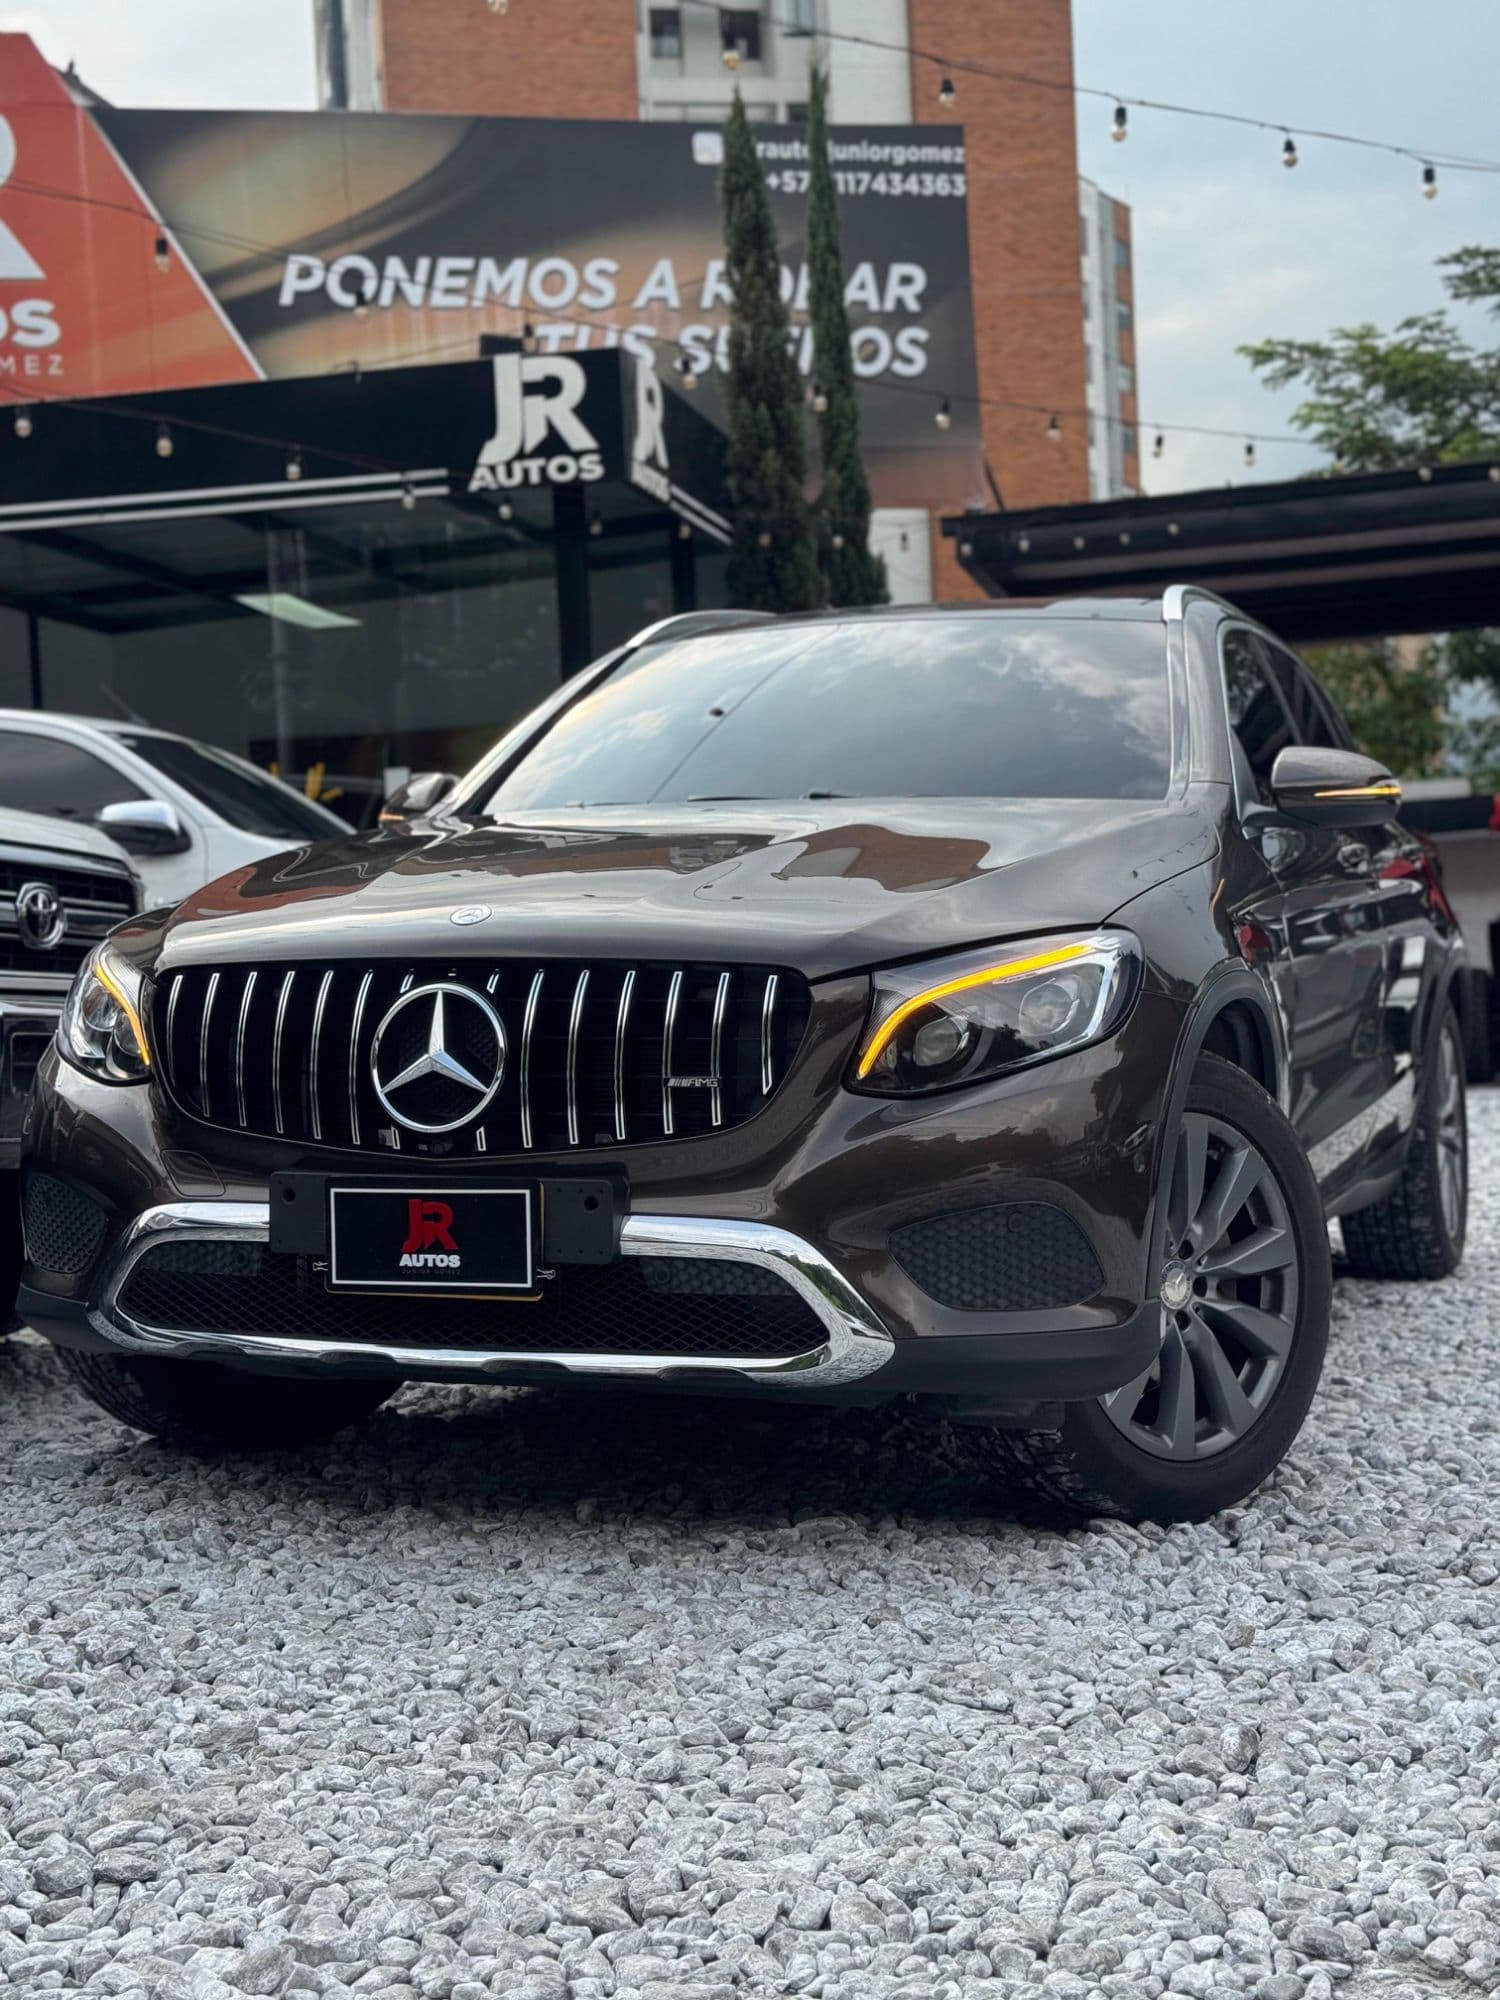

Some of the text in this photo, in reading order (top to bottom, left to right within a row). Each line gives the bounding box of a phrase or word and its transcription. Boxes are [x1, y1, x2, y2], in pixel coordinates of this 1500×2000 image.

[834, 172, 967, 197] 117434363
[279, 254, 620, 310] PONEMOS
[633, 258, 682, 310] A
[478, 353, 600, 466] JR
[467, 453, 605, 493] AUTOS
[401, 1199, 459, 1253] JR
[399, 1253, 461, 1268] AUTOS
